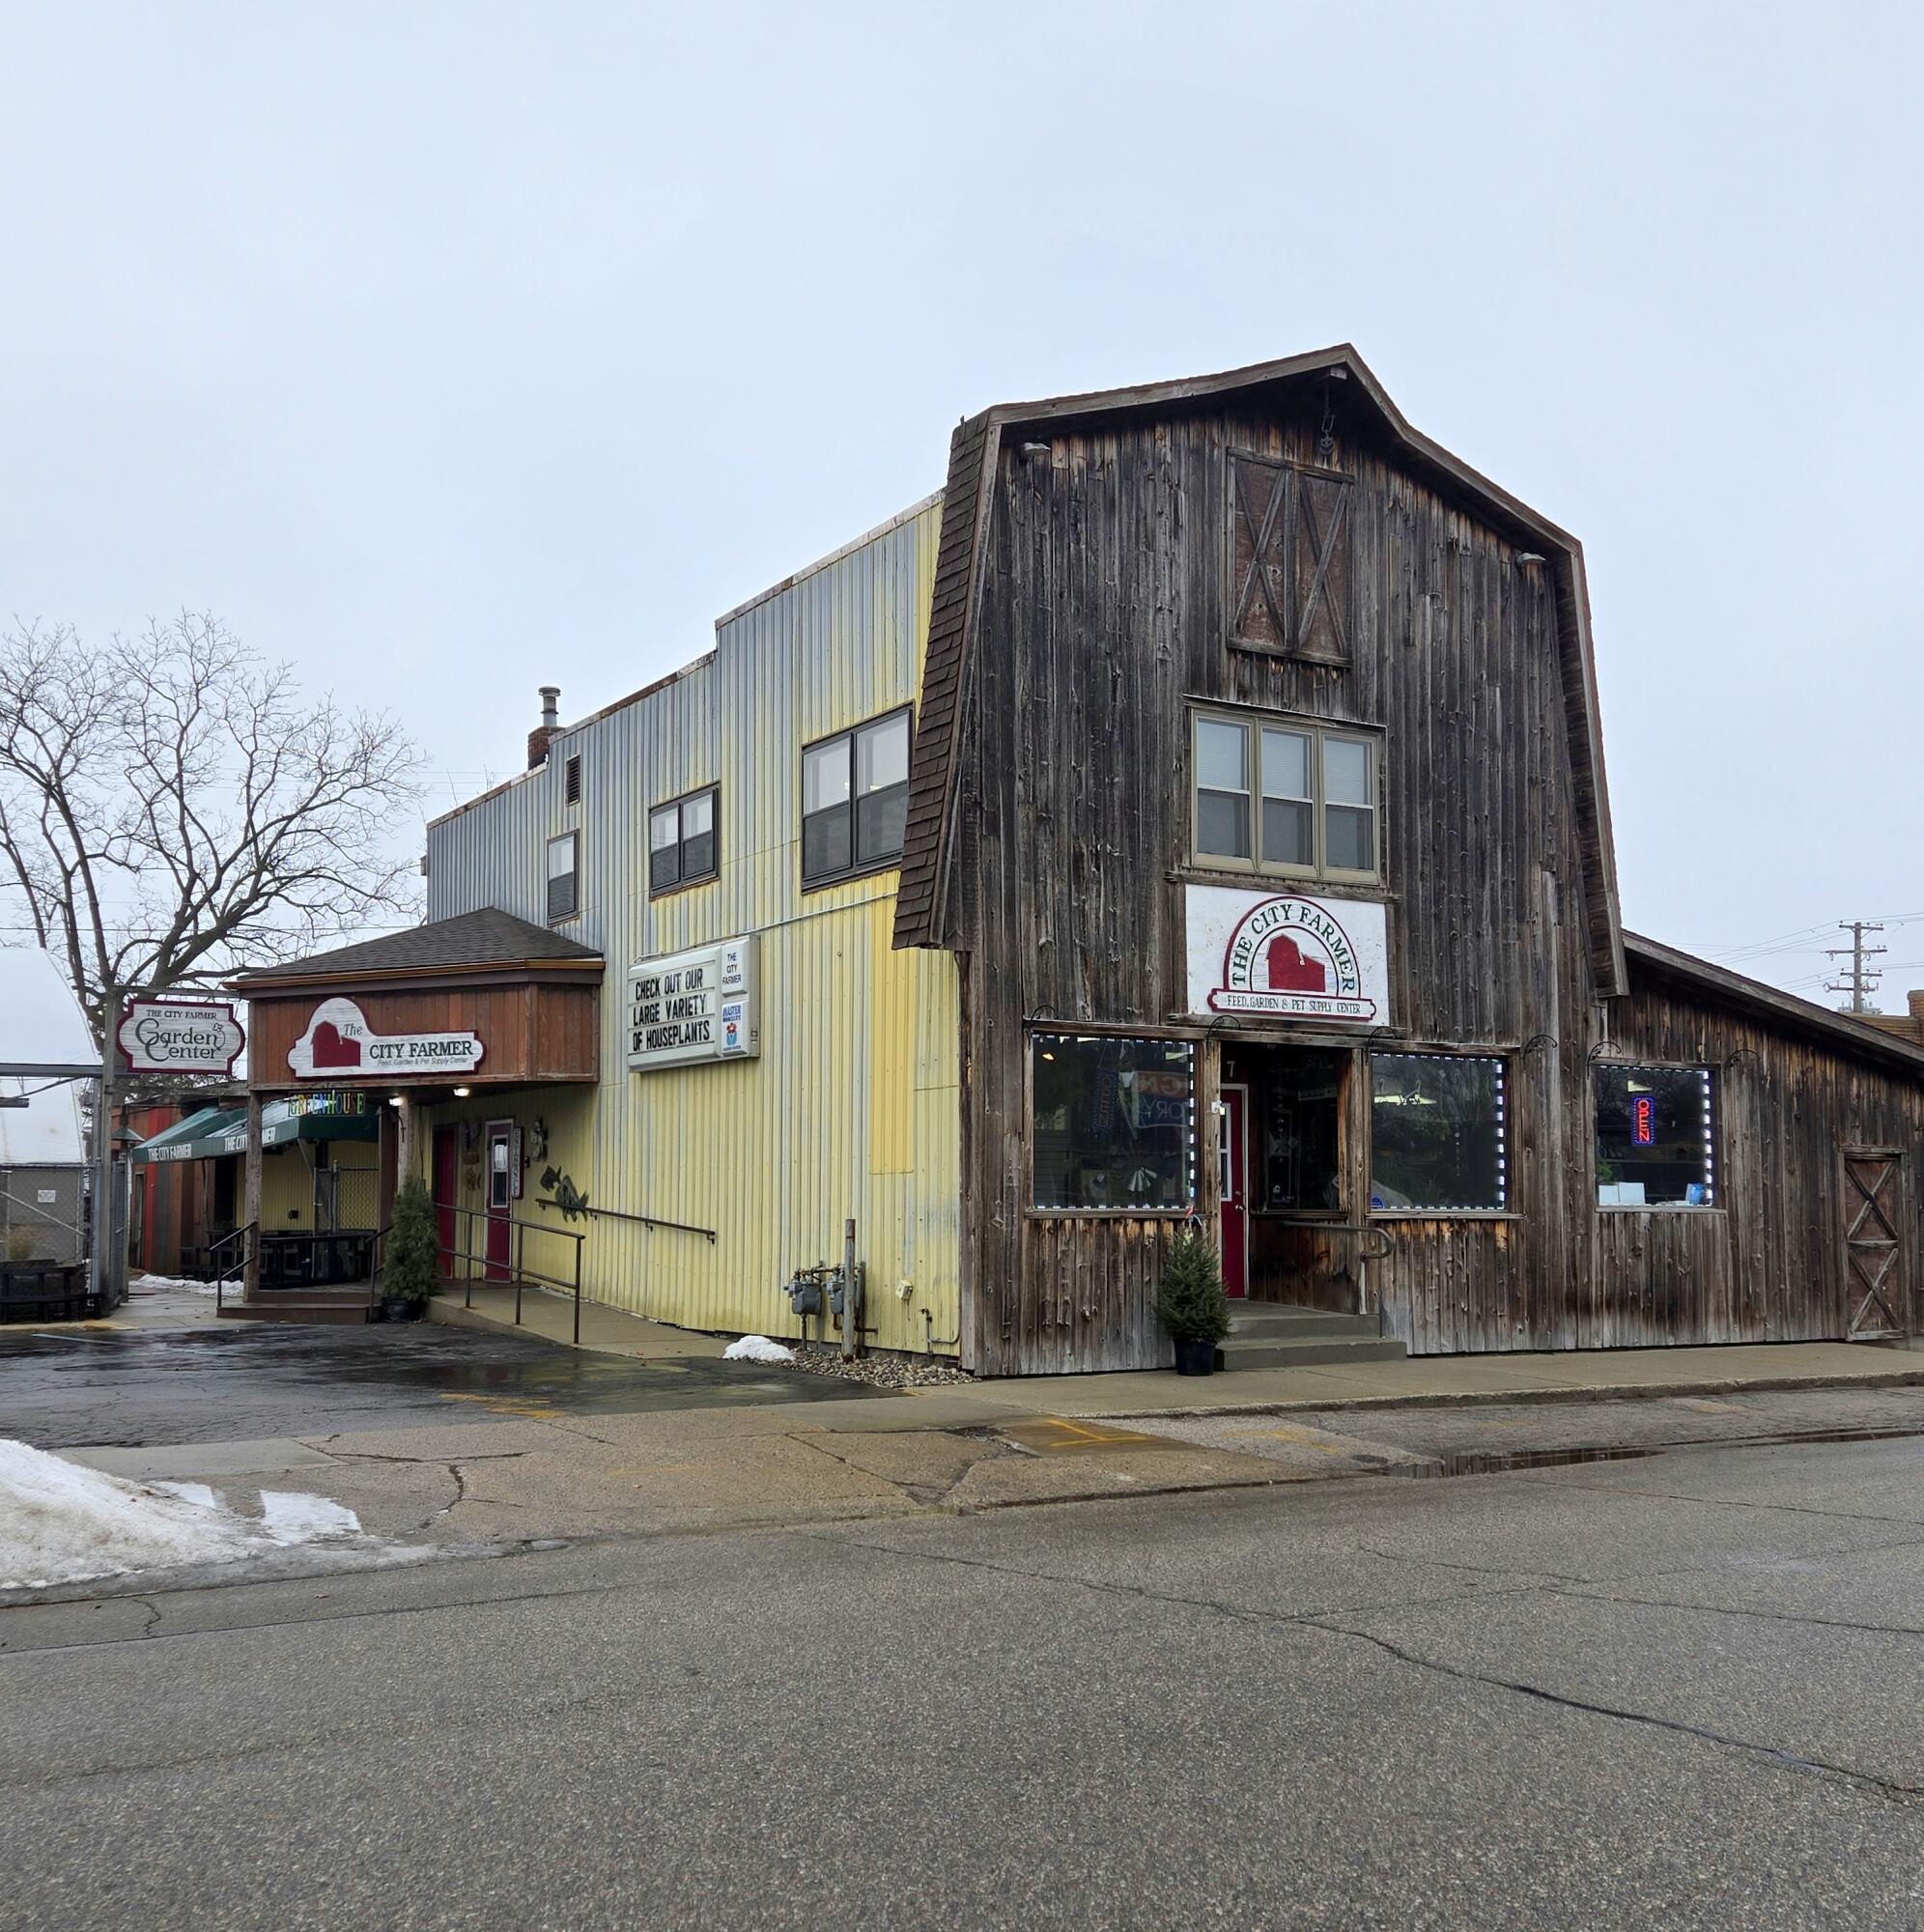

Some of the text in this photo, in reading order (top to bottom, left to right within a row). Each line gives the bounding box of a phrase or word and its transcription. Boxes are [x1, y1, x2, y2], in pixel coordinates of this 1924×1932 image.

[727, 952, 737, 962] THE
[1232, 903, 1355, 993] THE CITY FARMER
[726, 964, 738, 974] CITY
[635, 968, 703, 1001] CHECK OUT OUR
[722, 975, 742, 985] FARMER
[164, 1010, 184, 1019] CITY
[185, 1010, 217, 1020] FARMER
[634, 993, 706, 1026] LARGE VARIETY
[1250, 997, 1279, 1009] GARDEN
[1282, 1000, 1288, 1009] &
[1292, 999, 1305, 1010] PET
[1309, 1001, 1332, 1012] SUPPLY
[1337, 1002, 1361, 1014] CENTER
[135, 1018, 220, 1048] Garden
[344, 1023, 363, 1036] The
[633, 1020, 710, 1052] OF HOUSEPLANTS
[145, 1037, 221, 1062] Center
[369, 1040, 473, 1060] CITY FARMER
[1226, 1061, 1235, 1078] 7
[290, 1091, 364, 1116] GREENHOUSE
[1637, 1099, 1650, 1142] OPEN
[148, 1143, 192, 1162] THE CITY FARMER
[224, 1136, 236, 1151] THE
